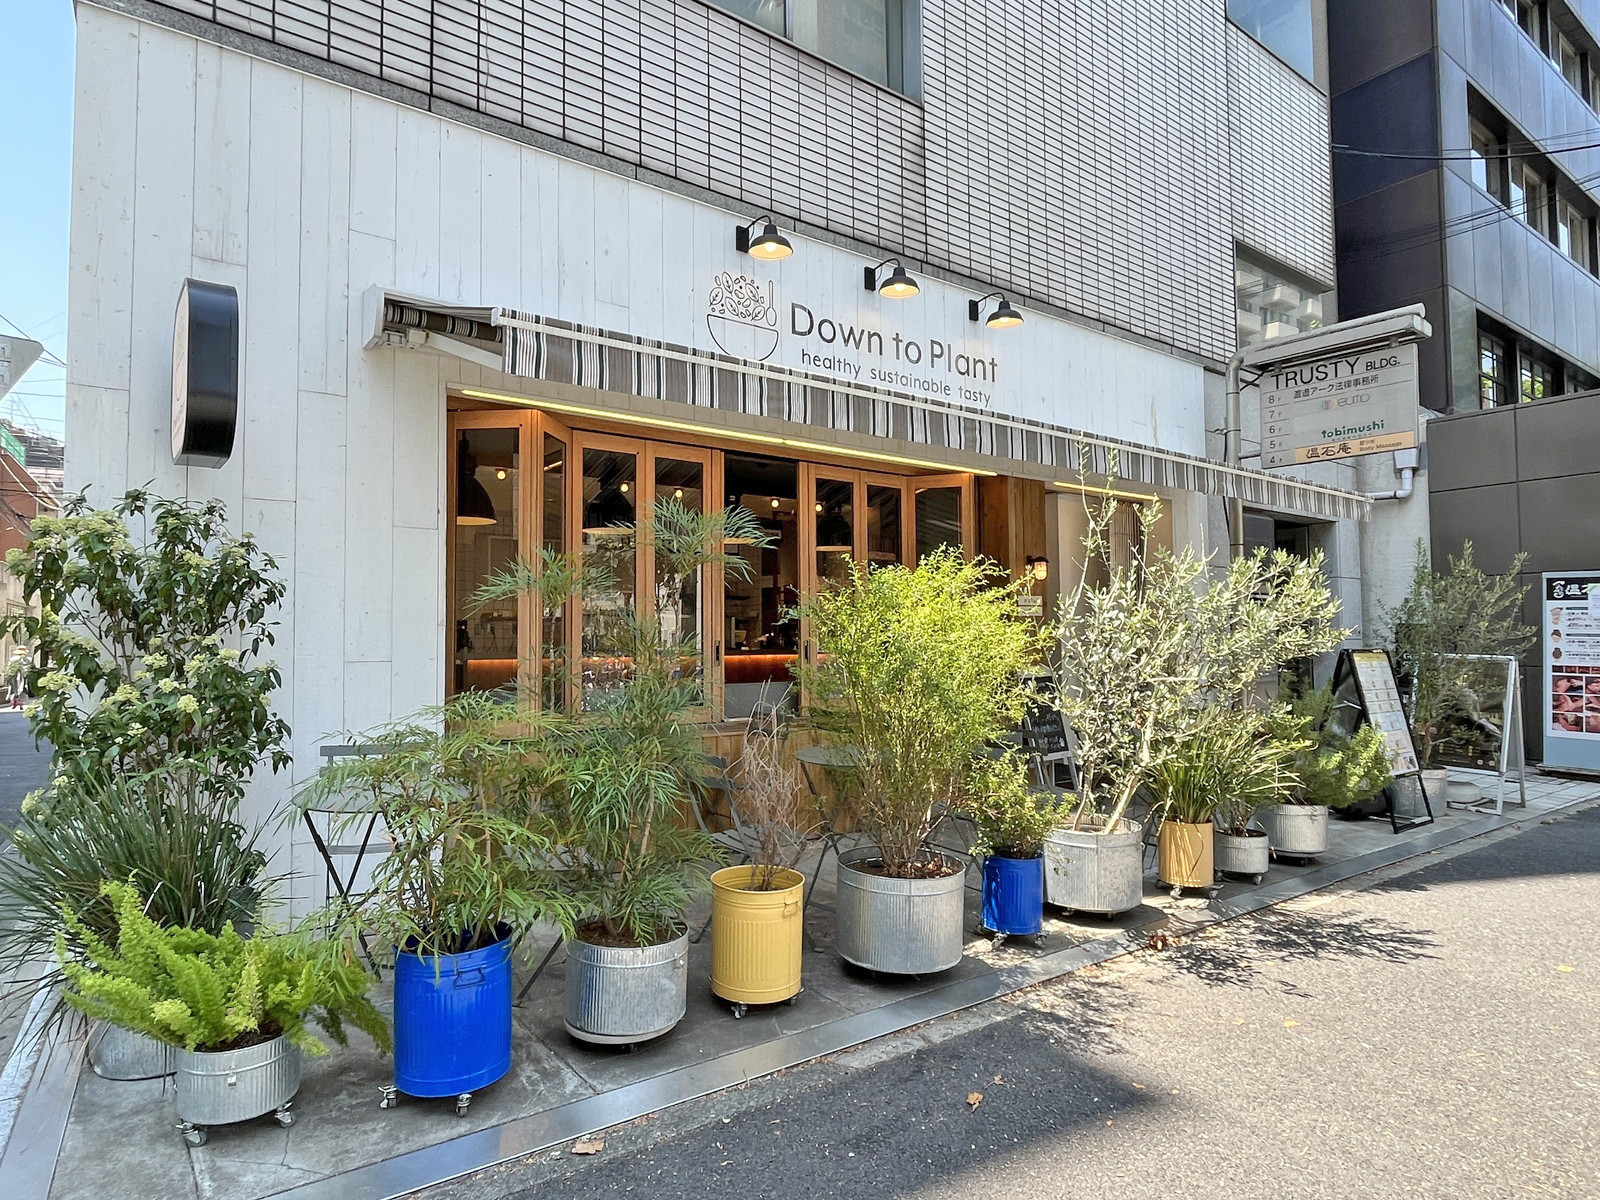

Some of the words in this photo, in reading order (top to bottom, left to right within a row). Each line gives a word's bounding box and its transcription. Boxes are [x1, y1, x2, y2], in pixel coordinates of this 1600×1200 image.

[790, 302, 883, 356] Down
[892, 332, 922, 365] to
[930, 339, 998, 382] Plant
[801, 348, 861, 379] healthy
[870, 366, 951, 396] sustainable
[958, 385, 991, 407] tasty
[1271, 357, 1360, 390] TRUSTY
[1366, 356, 1400, 371] BLDG.
[1321, 420, 1384, 438] tobimushi
[1306, 443, 1351, 459] 温石庵
